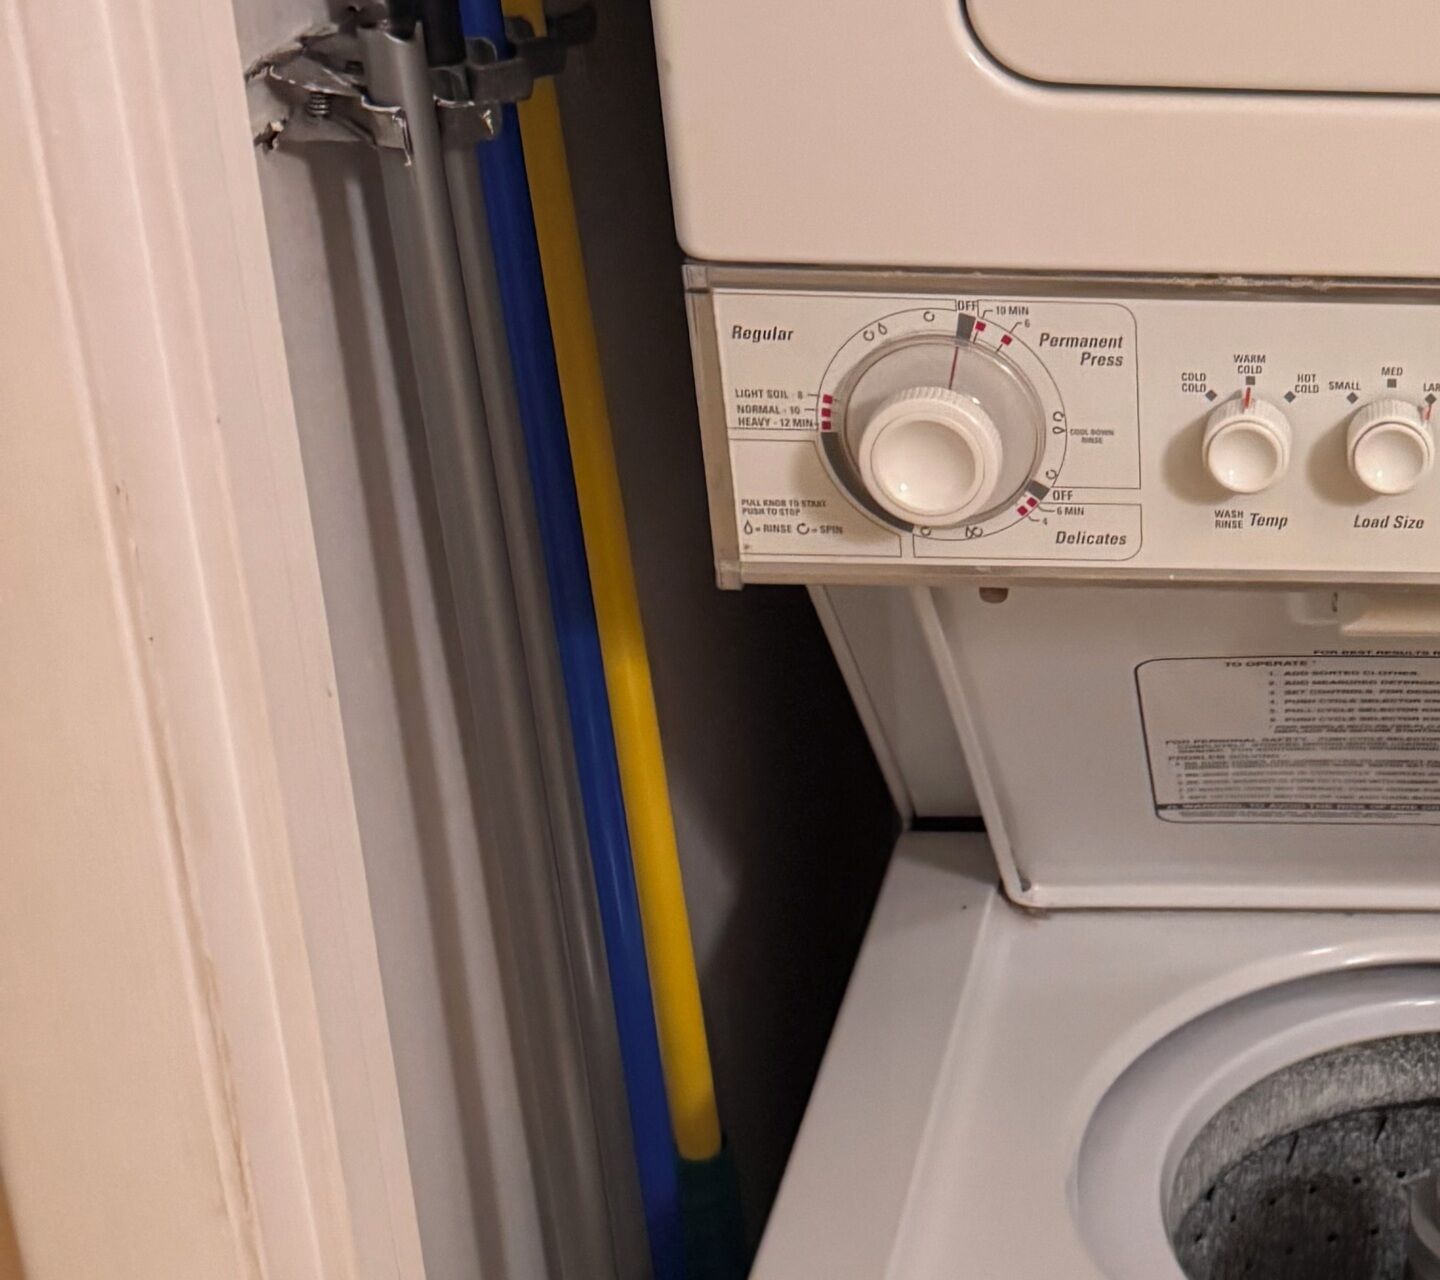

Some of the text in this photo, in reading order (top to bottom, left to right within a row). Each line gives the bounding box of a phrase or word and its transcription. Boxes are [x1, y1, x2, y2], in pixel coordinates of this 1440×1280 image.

[957, 300, 977, 312] OFF
[996, 306, 1030, 316] 10 MIN
[731, 325, 795, 345] Regular
[1038, 332, 1124, 350] Permanent
[1080, 352, 1124, 367] Press
[1233, 354, 1267, 364] WARM
[1237, 365, 1263, 375] COLD
[1381, 366, 1404, 376] MED
[1181, 372, 1207, 382] COLD
[1297, 373, 1317, 383] HOT
[1181, 383, 1207, 393] COLD
[1294, 384, 1320, 394] COLD
[1328, 381, 1362, 391] SMALL
[735, 389, 763, 399] LIGHT
[765, 390, 789, 399] SOIL
[737, 404, 801, 415] NORMAL 10
[738, 417, 814, 427] HEAVY 12 MIN
[1052, 489, 1074, 501] OFF
[741, 499, 761, 507] PULL
[763, 499, 787, 507] KNOB
[789, 499, 800, 507] TO
[742, 508, 801, 517] PUSH TO STOP
[1056, 507, 1085, 516] 6 MIN
[1214, 510, 1244, 519] WASH
[1214, 519, 1244, 529] RINSE
[1249, 512, 1288, 529] Temp
[1353, 514, 1425, 529] Load Size
[763, 523, 844, 535] RINSE SPIN
[1055, 530, 1128, 546] Delicates
